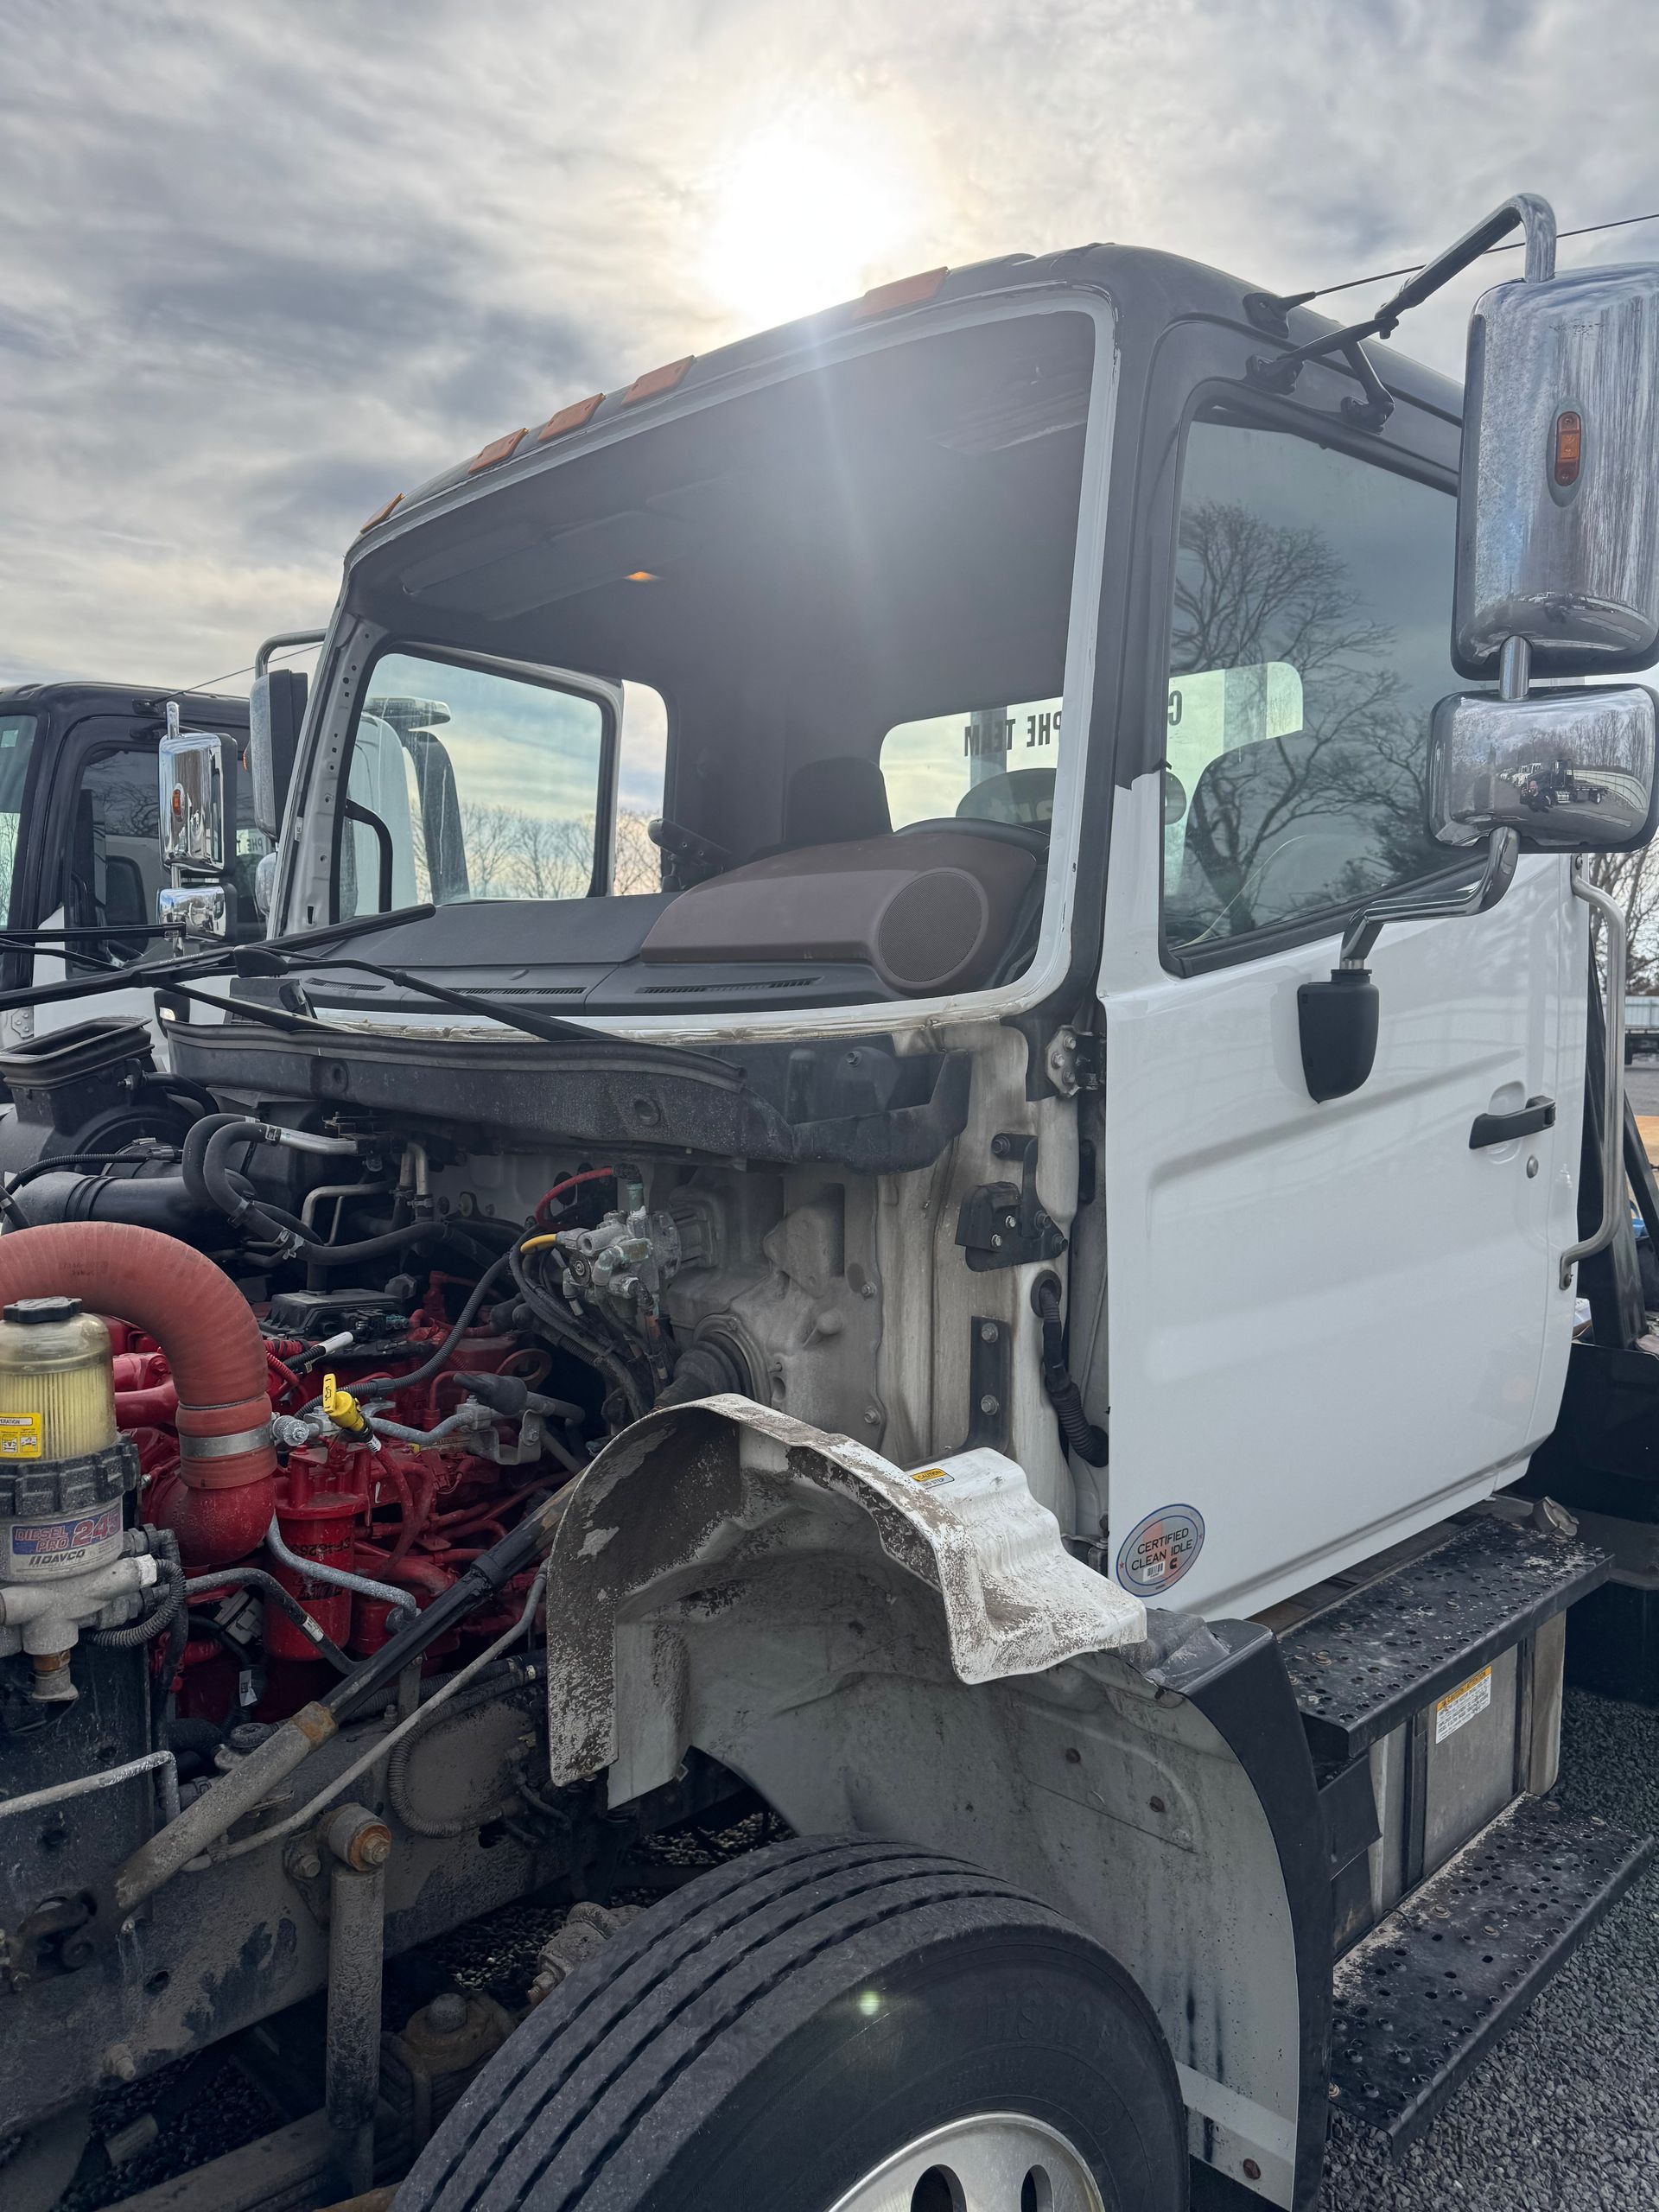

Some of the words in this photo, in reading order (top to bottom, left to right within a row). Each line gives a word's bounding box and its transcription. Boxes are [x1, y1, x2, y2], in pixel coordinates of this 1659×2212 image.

[918, 1470, 942, 1479] CAUTION
[15, 1525, 69, 1541] DIESEL
[1137, 1527, 1189, 1554] CERTIFIED
[35, 1537, 69, 1553] PRO
[40, 1548, 86, 1565] DAVCO
[1131, 1549, 1167, 1571] CLEAN
[1171, 1539, 1193, 1556] IDLE
